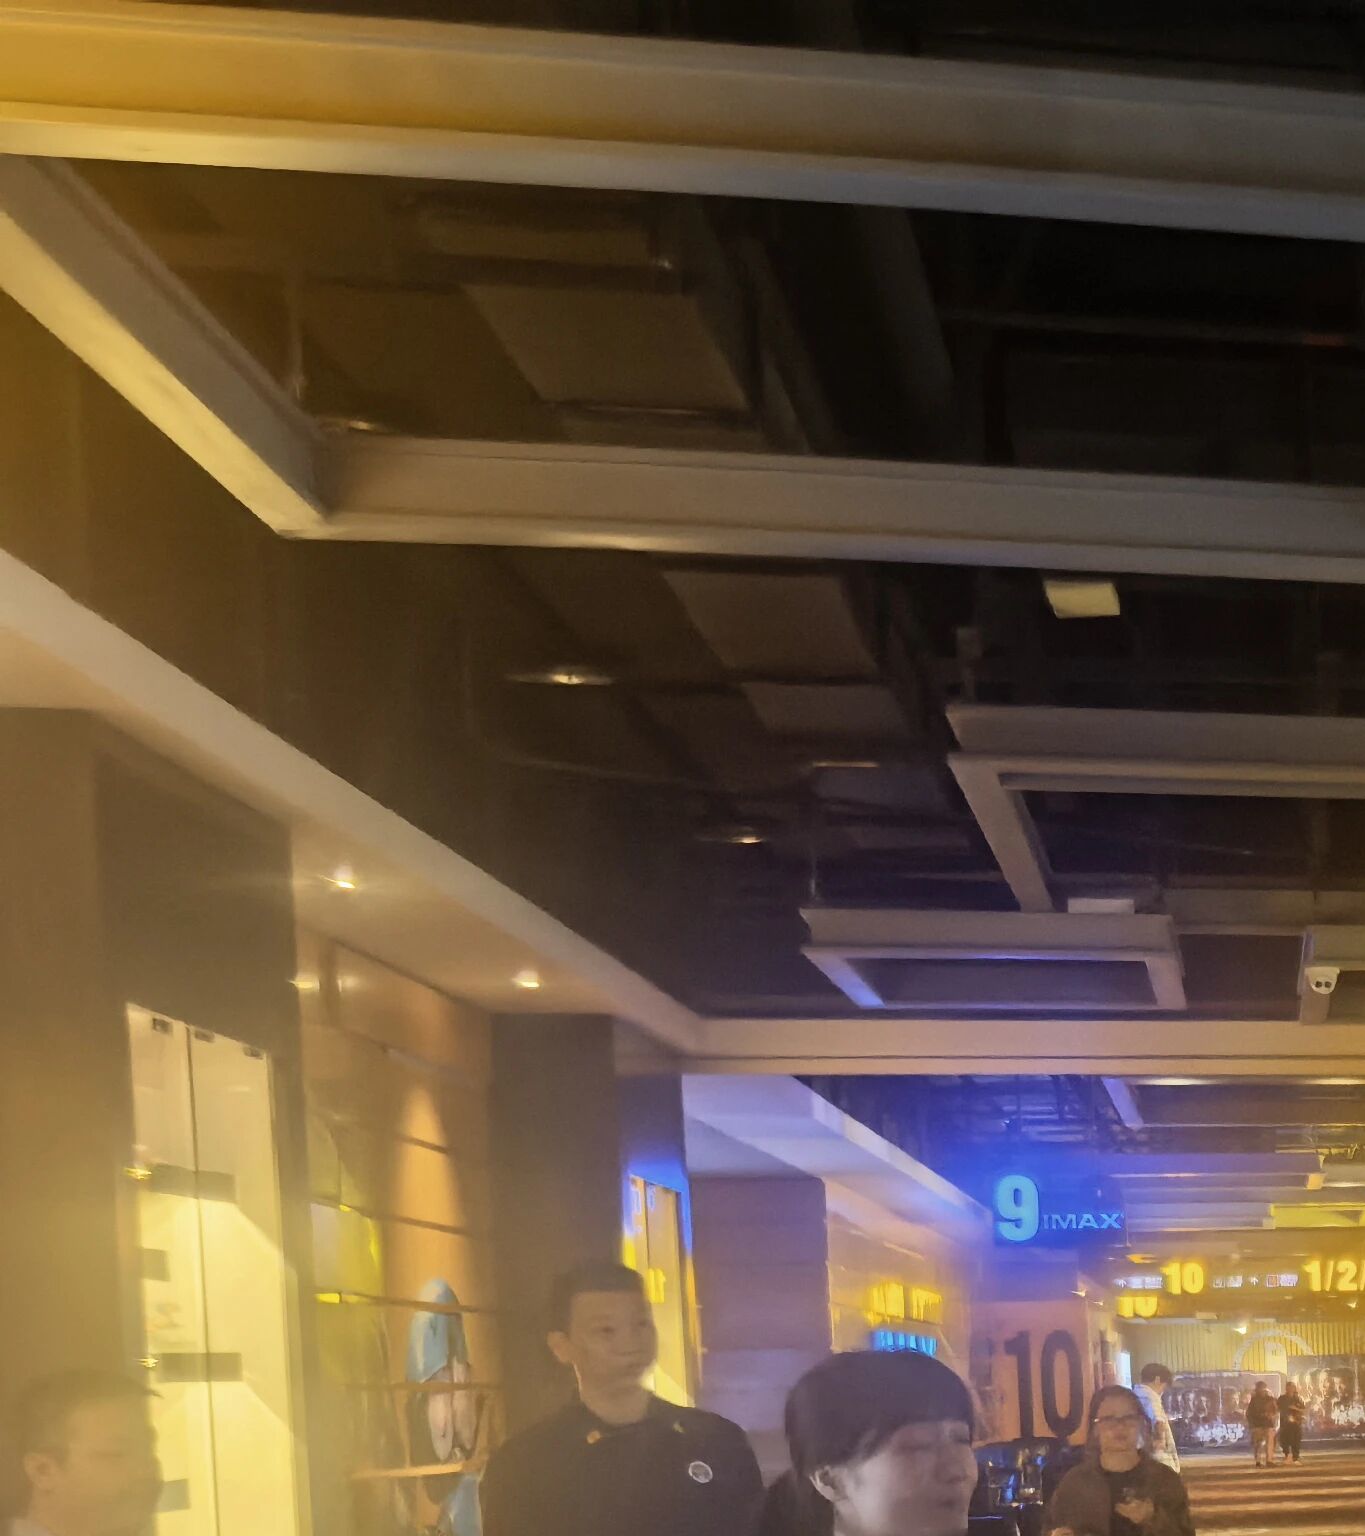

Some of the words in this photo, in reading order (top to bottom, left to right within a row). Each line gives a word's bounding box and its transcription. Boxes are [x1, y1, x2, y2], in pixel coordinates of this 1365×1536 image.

[996, 1175, 1040, 1242] 9
[1043, 1213, 1122, 1230] IMAX
[1161, 1262, 1204, 1295] 10
[1004, 1329, 1084, 1439] 10
